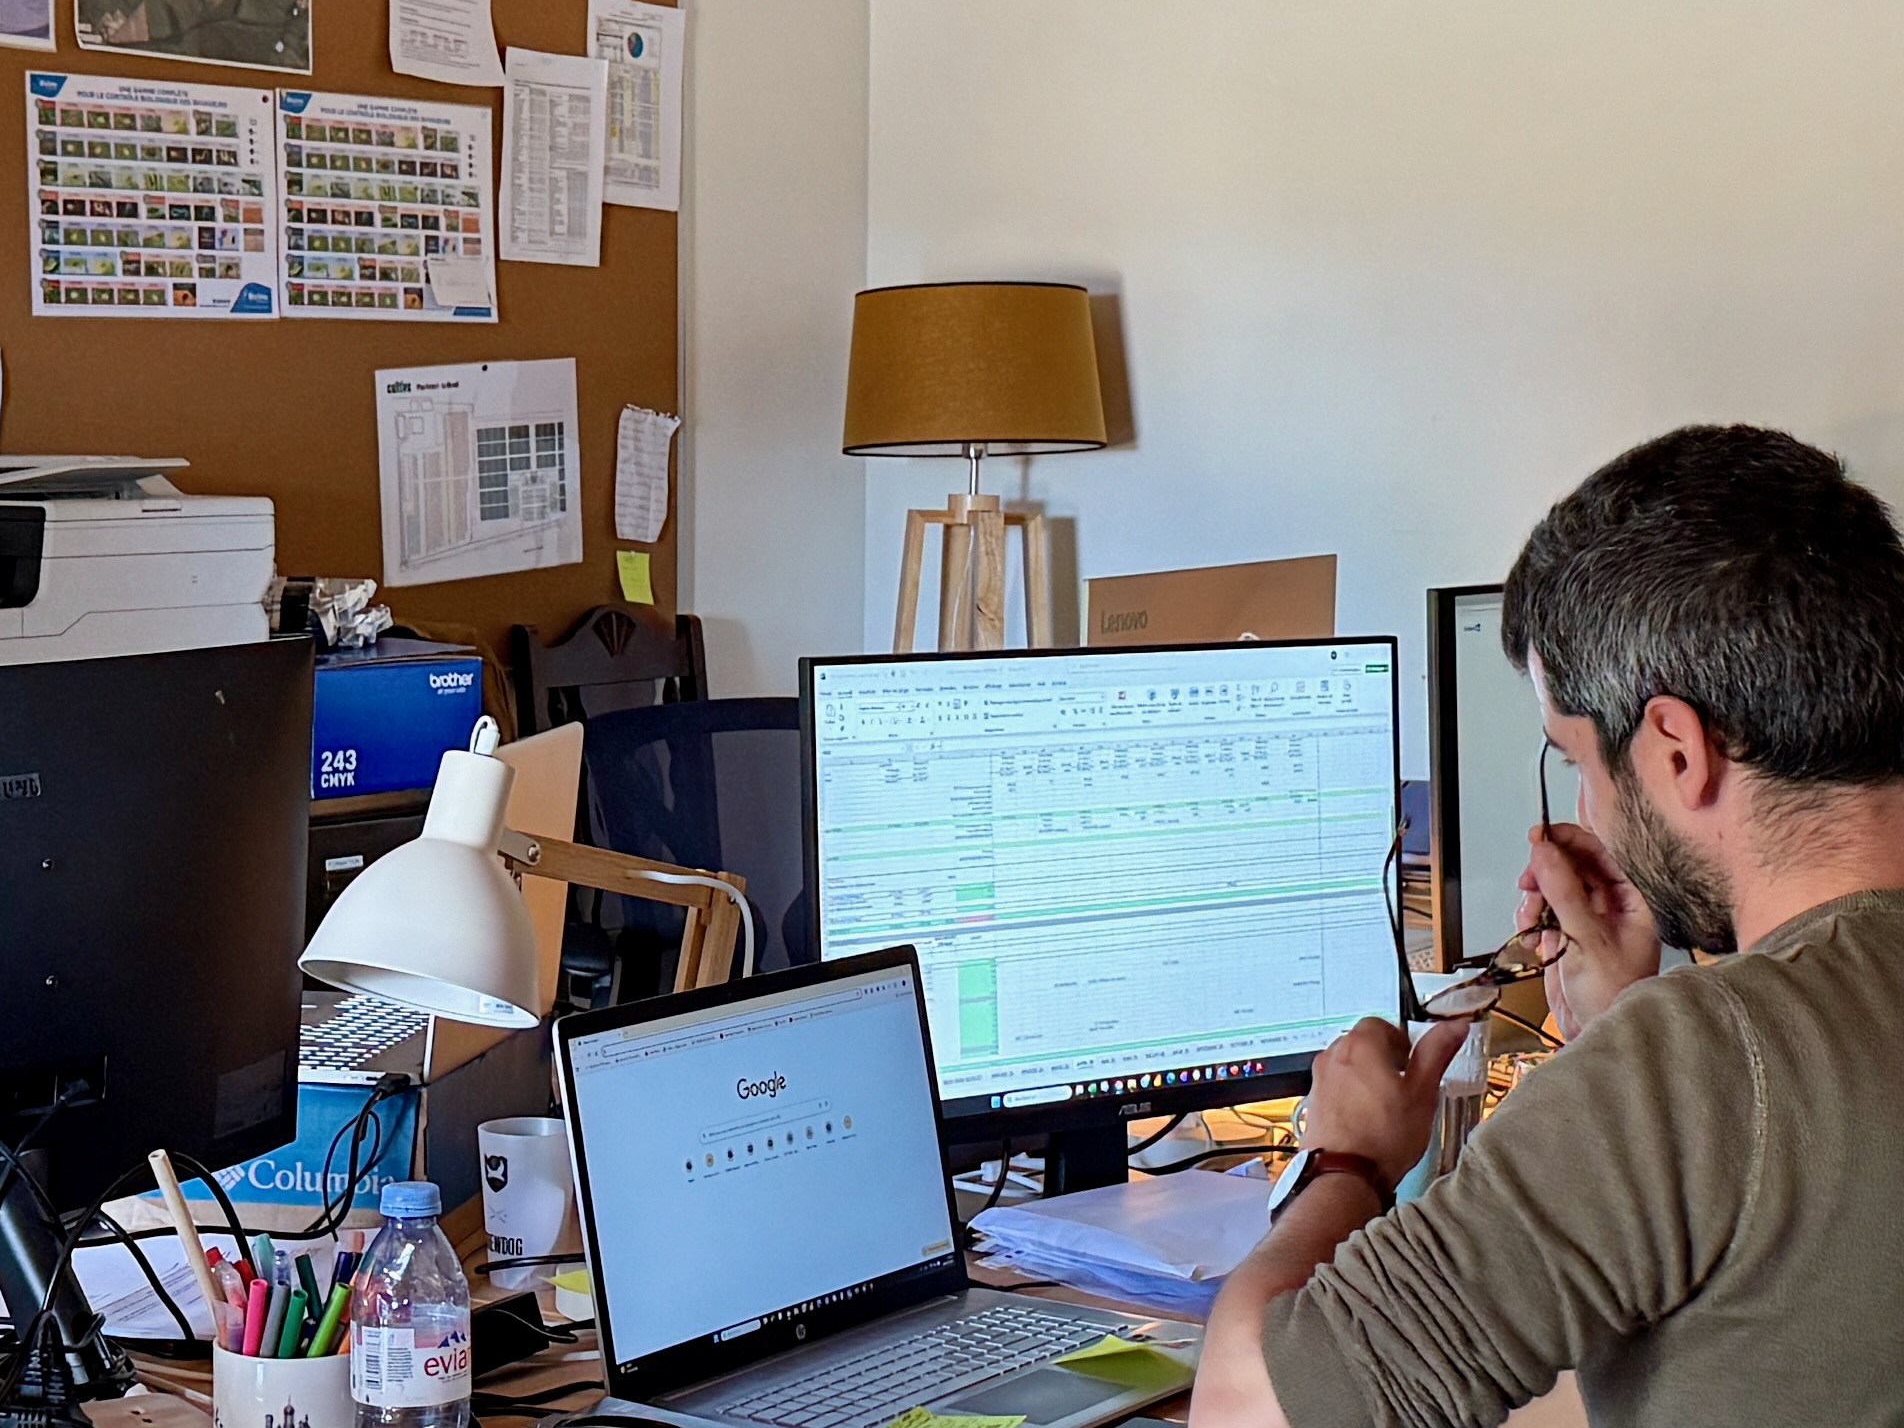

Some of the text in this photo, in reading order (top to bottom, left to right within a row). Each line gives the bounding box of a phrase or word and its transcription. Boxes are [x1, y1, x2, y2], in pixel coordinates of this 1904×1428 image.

[429, 672, 474, 688] brother
[321, 749, 357, 772] 243
[321, 771, 355, 788] CMYK
[737, 1071, 786, 1100] Google
[423, 1348, 470, 1377] evia
